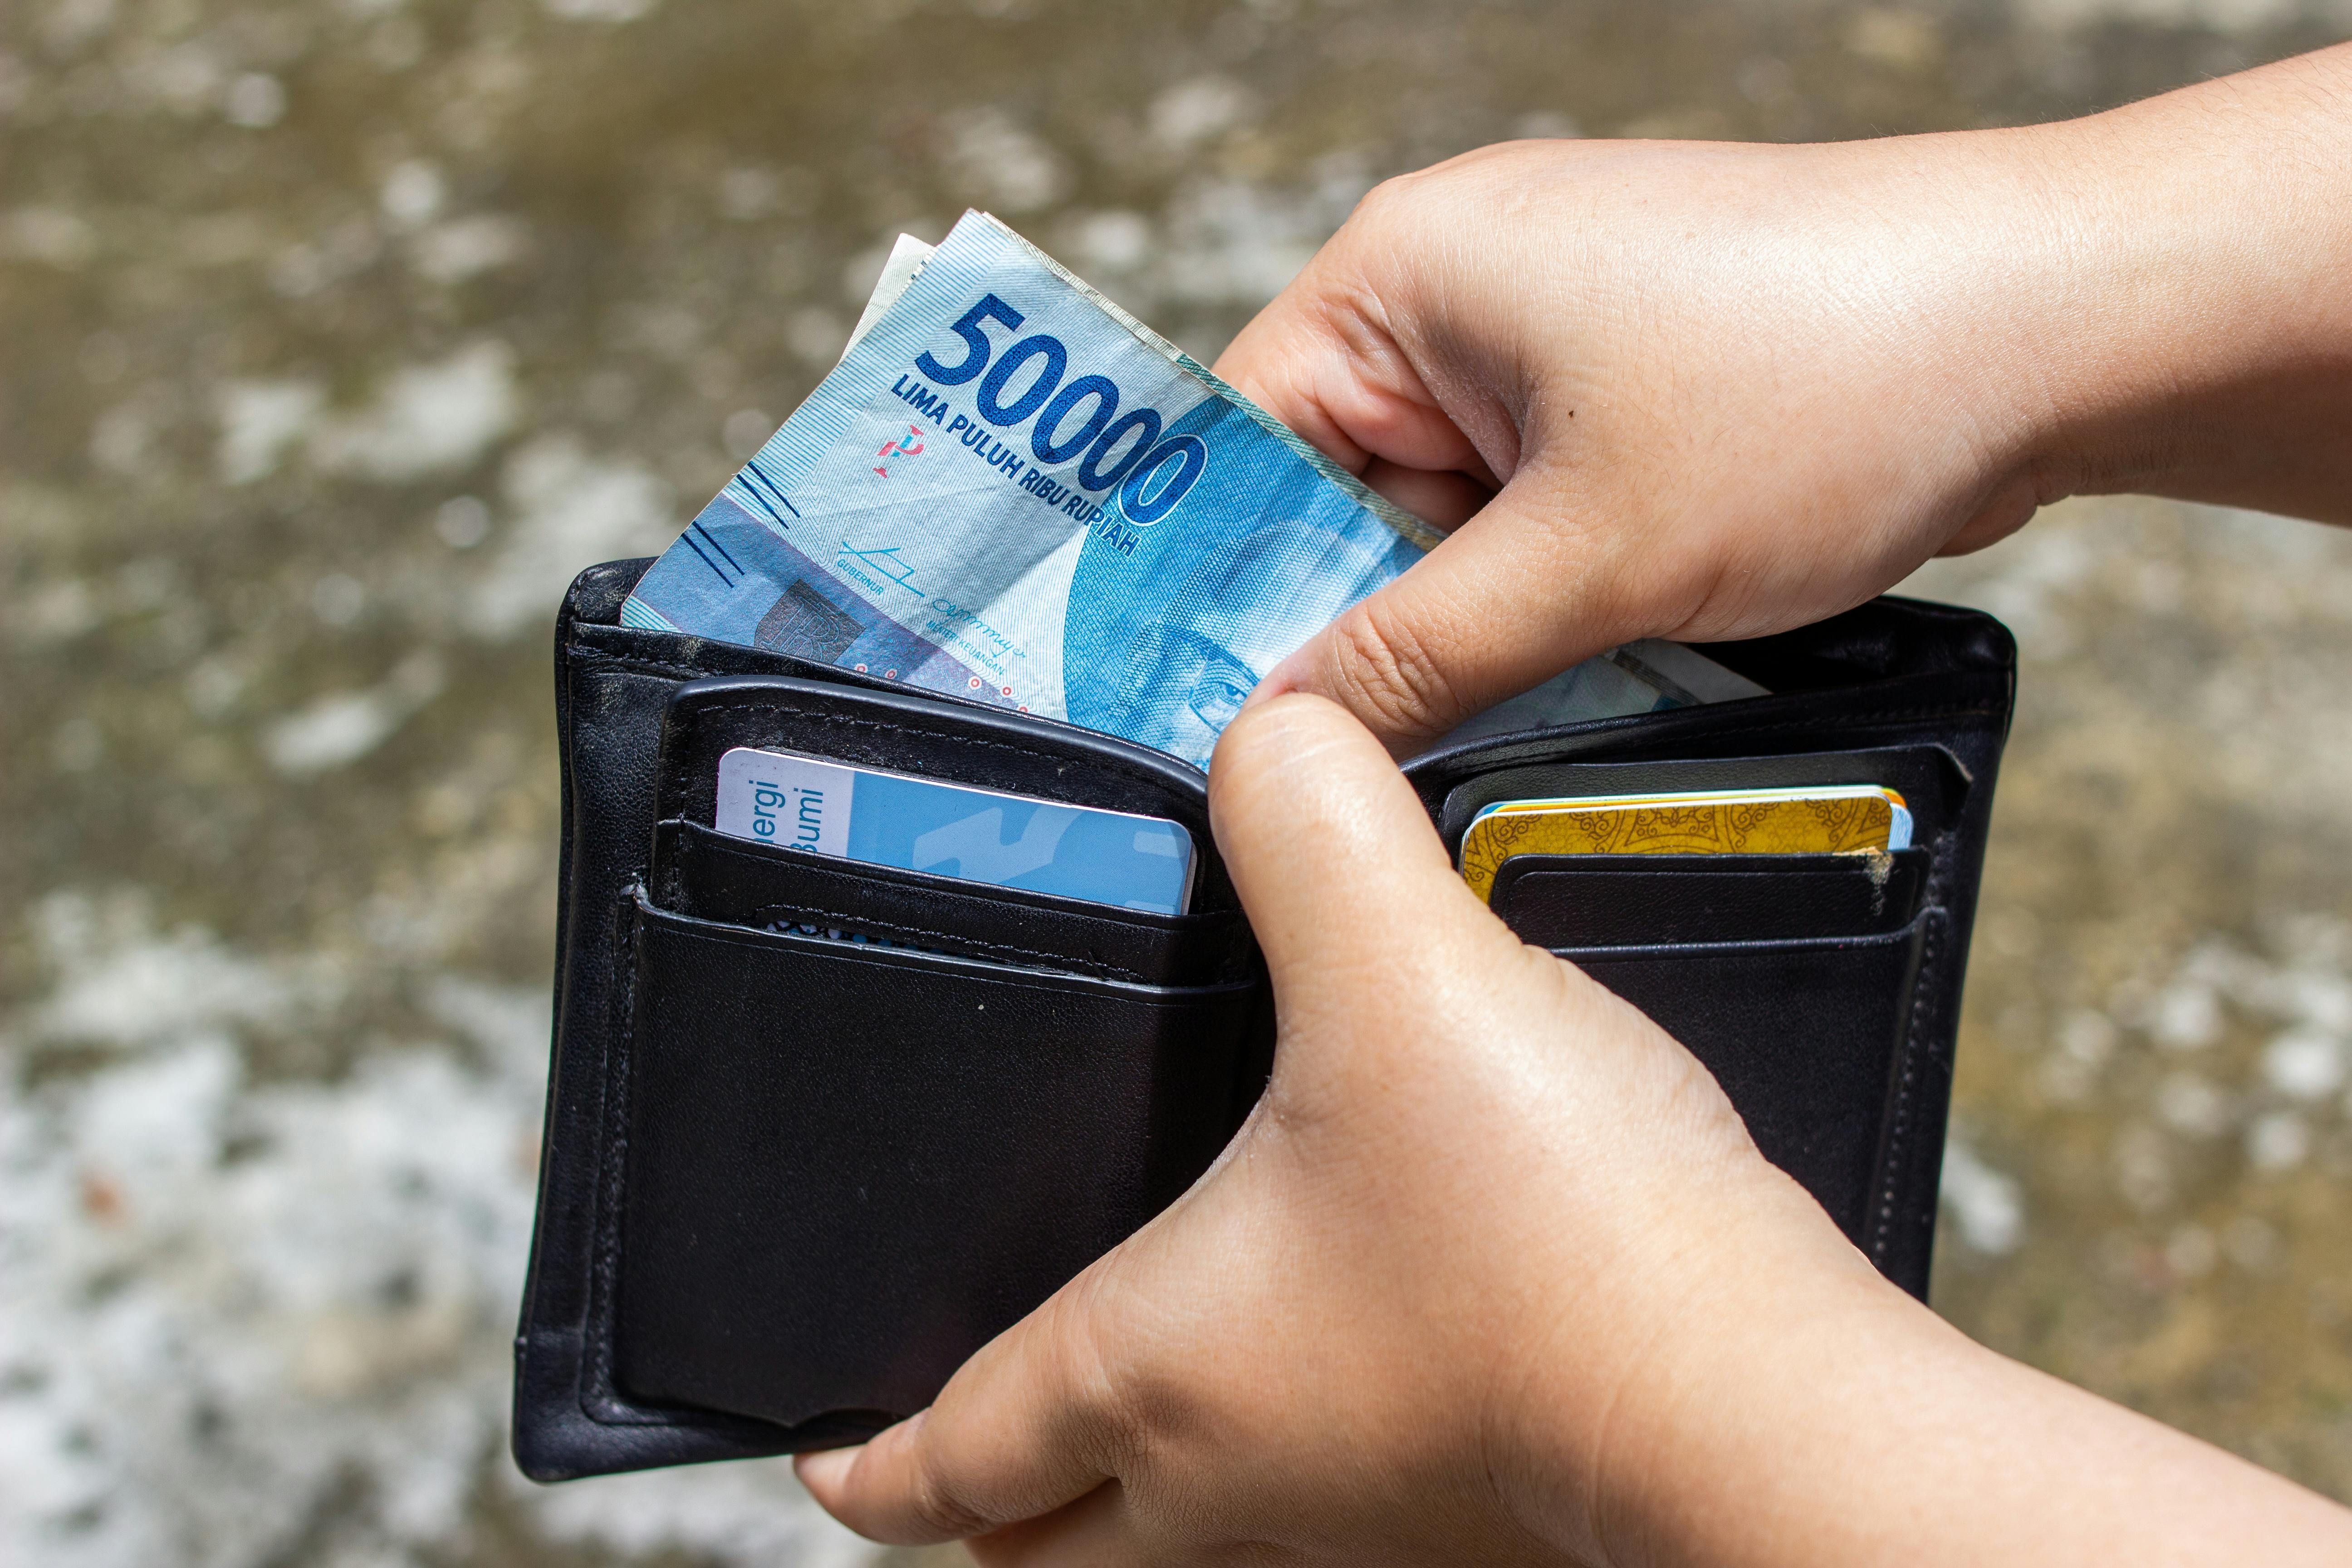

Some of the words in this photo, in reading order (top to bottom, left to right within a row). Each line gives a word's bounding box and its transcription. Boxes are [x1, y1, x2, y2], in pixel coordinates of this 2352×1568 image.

[914, 293, 1208, 526] 50000
[891, 373, 949, 425] LIMA
[946, 414, 1025, 480] PULUH
[1018, 468, 1070, 506] RIBU
[1060, 495, 1142, 558] RUPIAH
[837, 559, 884, 596] GUBERNUR
[926, 620, 959, 643] MENTERI
[958, 639, 1006, 676] KEUANGAN
[749, 779, 786, 843] ergi
